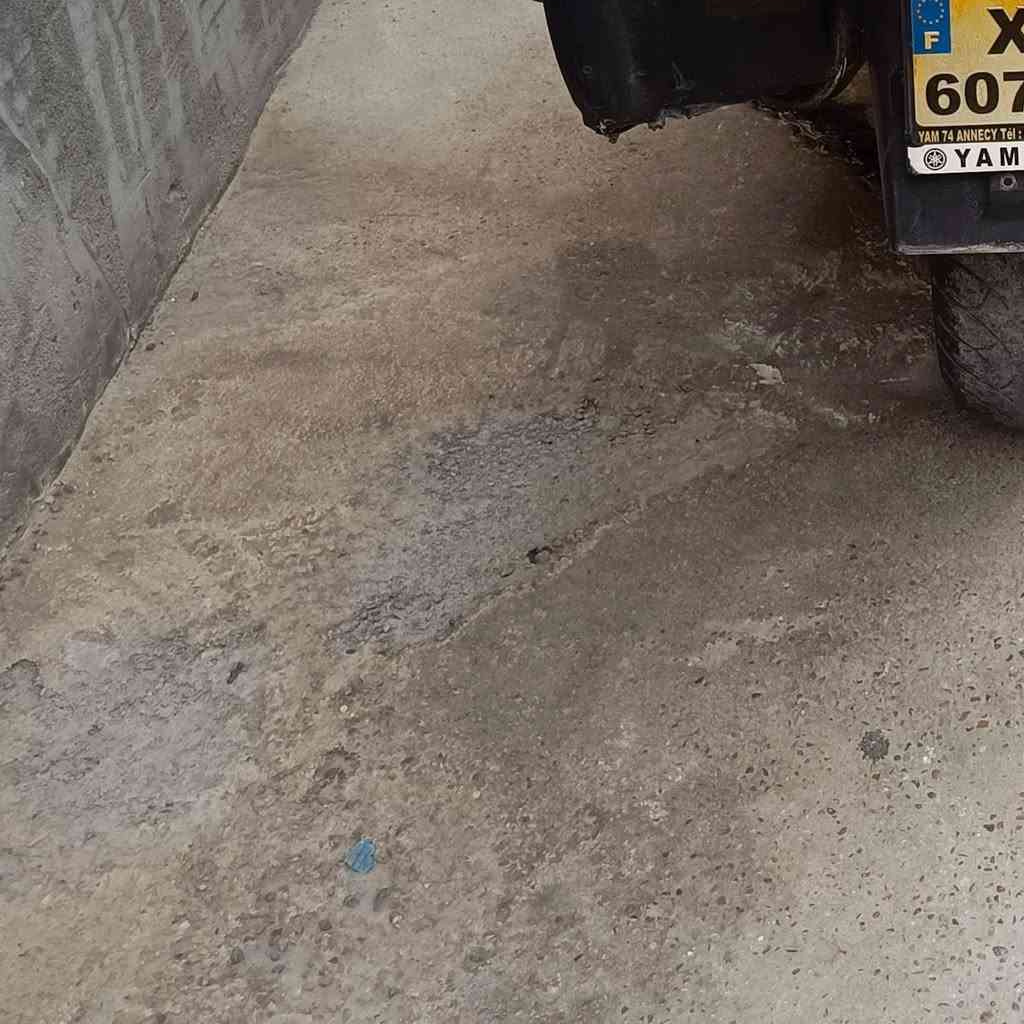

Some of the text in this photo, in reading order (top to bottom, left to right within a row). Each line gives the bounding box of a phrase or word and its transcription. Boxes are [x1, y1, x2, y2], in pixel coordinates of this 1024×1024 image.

[924, 32, 940, 49] F
[918, 130, 940, 143] YAM
[942, 129, 954, 141] 74
[956, 127, 998, 141] ANNECY
